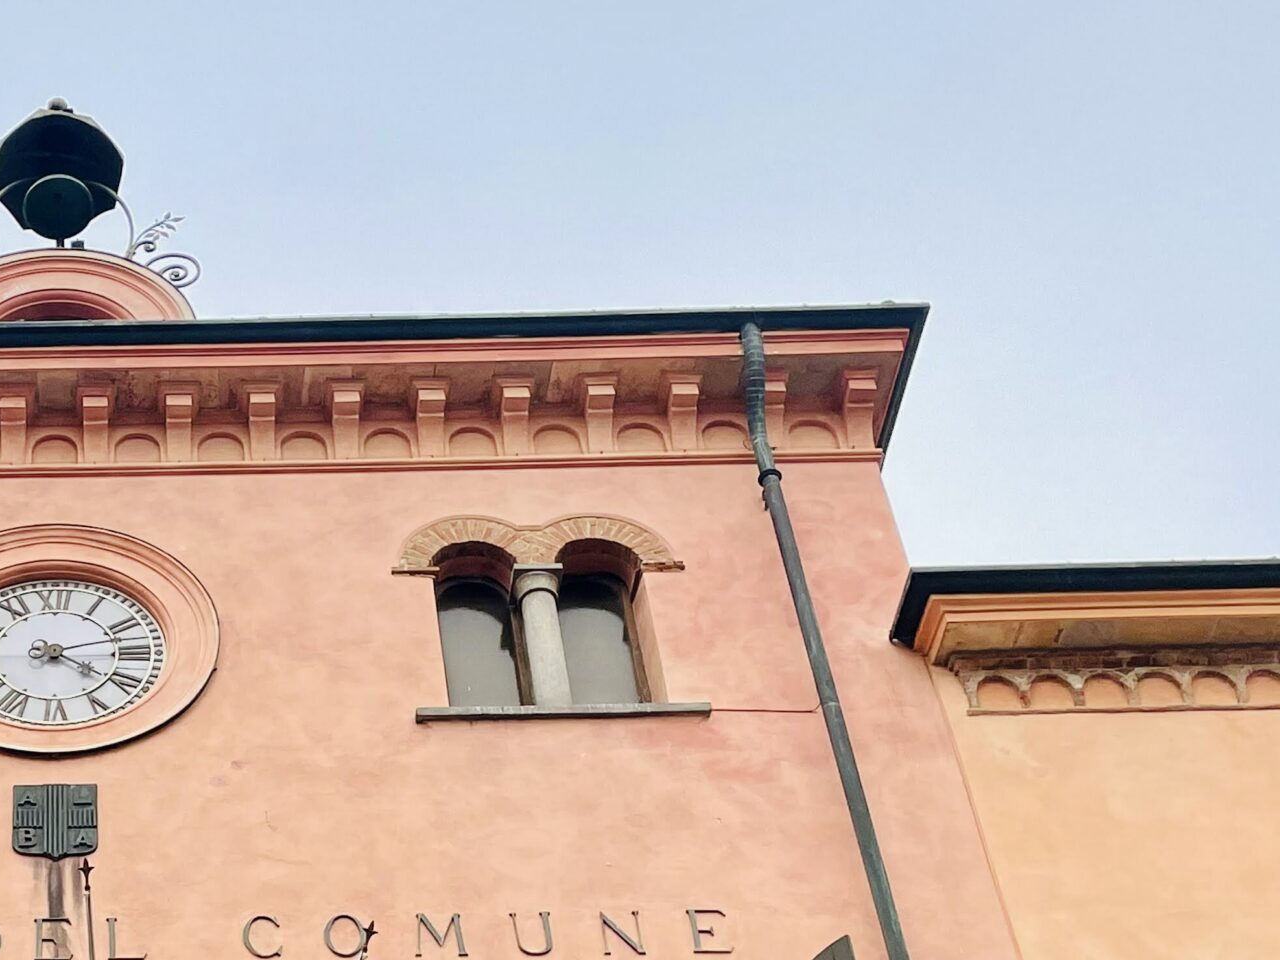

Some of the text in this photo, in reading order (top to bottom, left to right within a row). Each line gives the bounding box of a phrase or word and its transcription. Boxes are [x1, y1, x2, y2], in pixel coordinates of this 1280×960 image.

[36, 590, 72, 611] XII
[86, 596, 105, 616] I
[107, 614, 141, 635] II
[118, 645, 151, 662] III
[43, 700, 68, 721] VI
[87, 693, 111, 714] V
[19, 828, 38, 848] B
[242, 908, 734, 958] COMUNE
